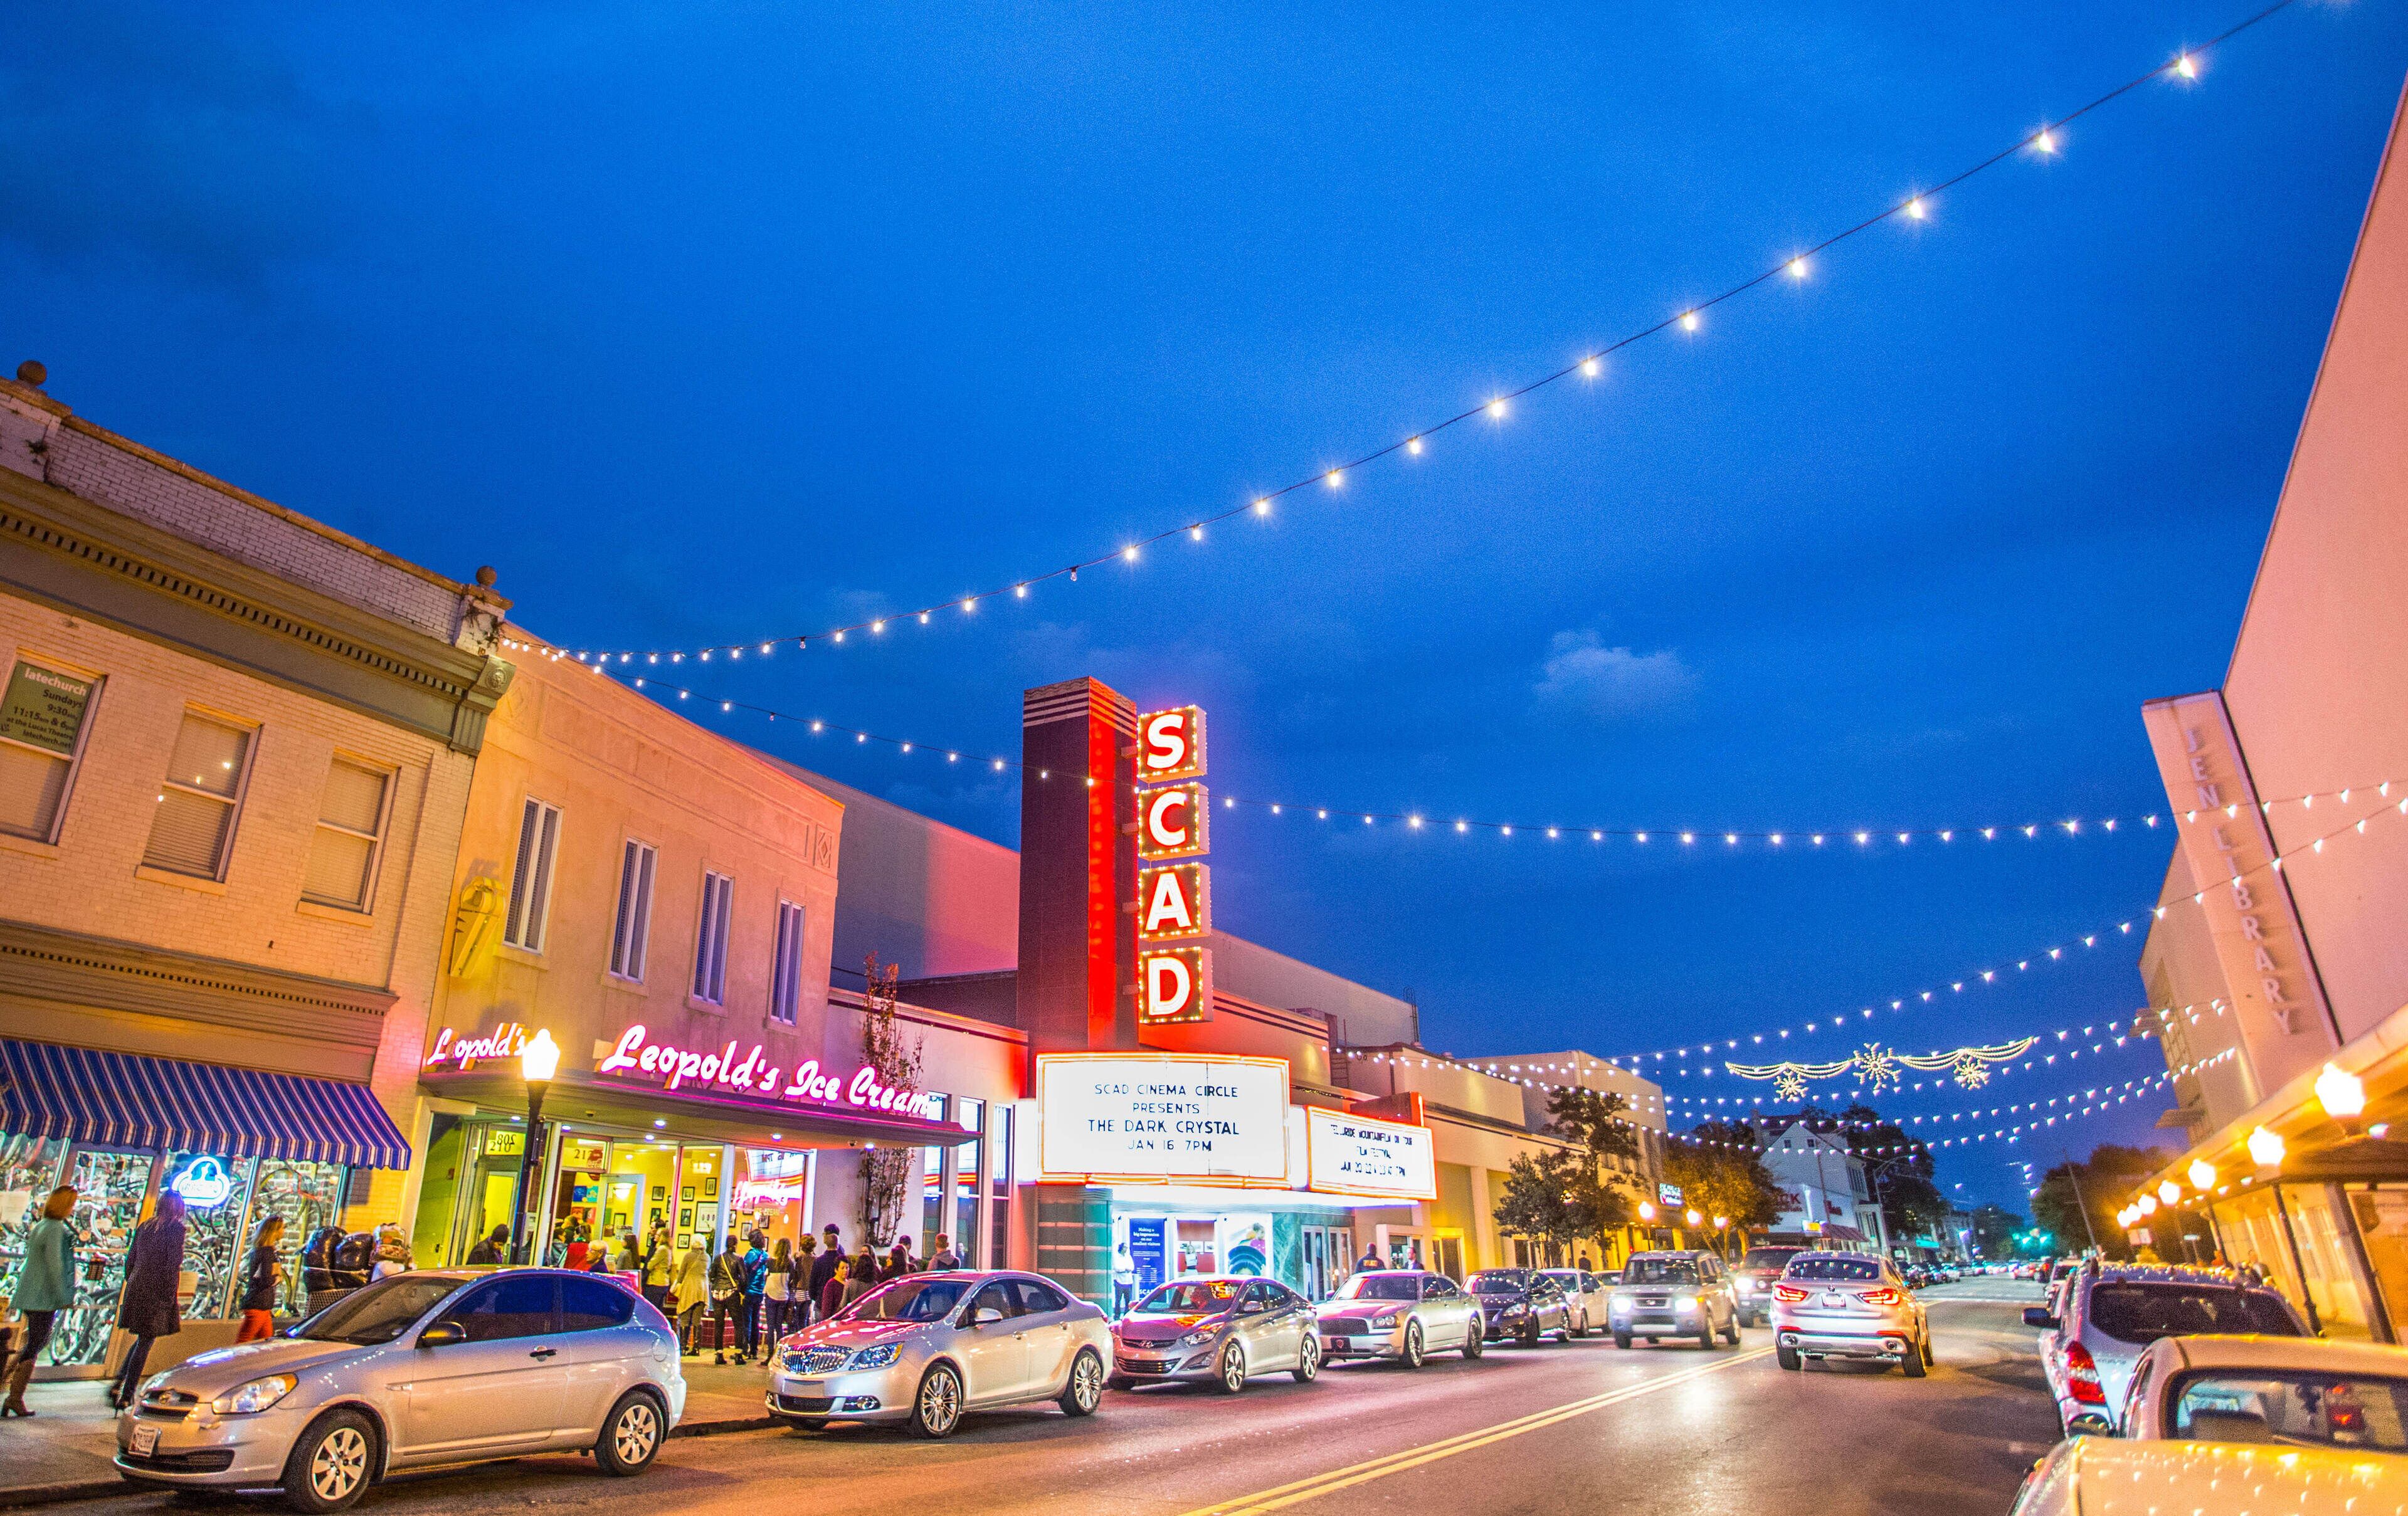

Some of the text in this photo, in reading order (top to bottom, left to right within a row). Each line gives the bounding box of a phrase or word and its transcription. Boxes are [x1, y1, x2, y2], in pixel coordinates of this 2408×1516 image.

[24, 667, 87, 696] latechurch
[43, 689, 83, 708] Sundays
[15, 718, 27, 727] the
[50, 717, 58, 726] &
[2186, 727, 2221, 809] JEN
[1145, 713, 1191, 1016] SCAD
[2212, 827, 2293, 1035] LIBRARY
[600, 1024, 931, 1115] Leopold's Ice Cream
[1095, 1084, 1238, 1097] SCAD CINEMA CIRCLE
[1133, 1102, 1200, 1114] PRESENTS
[1088, 1119, 1240, 1135] THE DARK CRYSTAL
[1128, 1139, 1212, 1152] JAN 16 7PM
